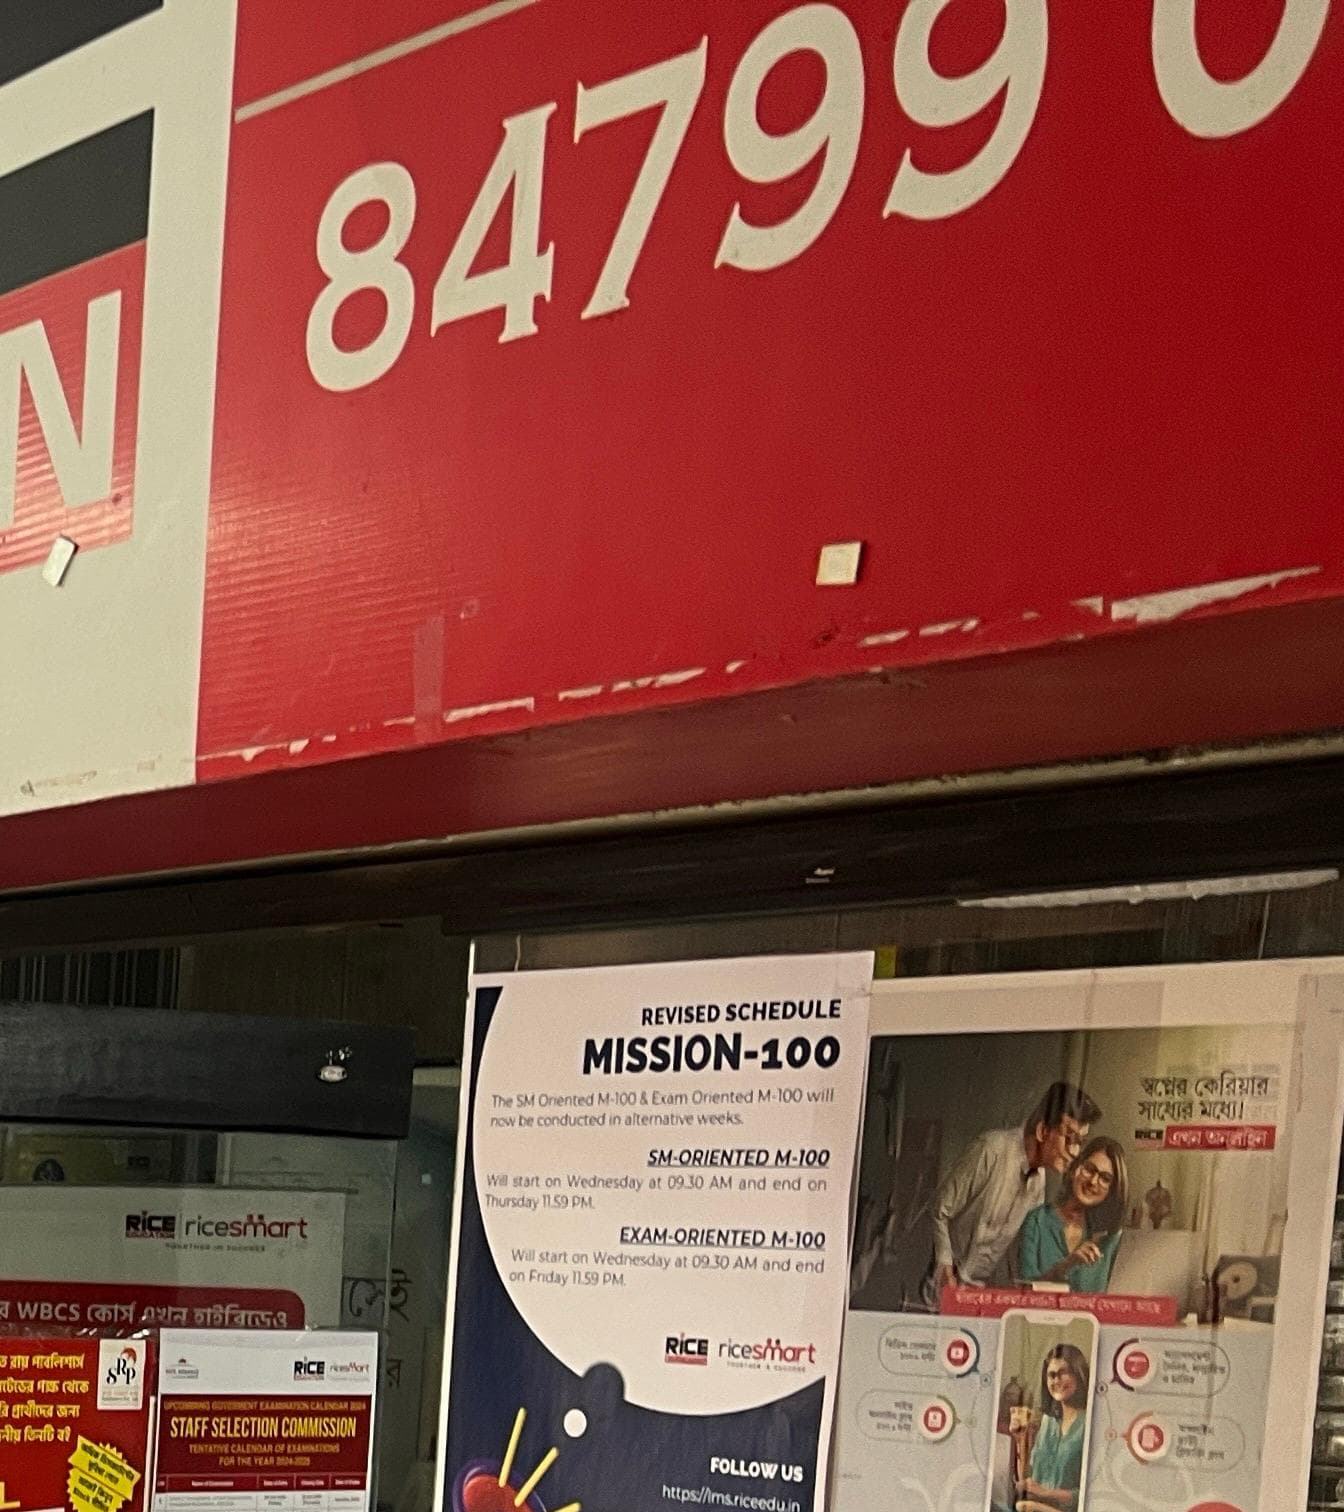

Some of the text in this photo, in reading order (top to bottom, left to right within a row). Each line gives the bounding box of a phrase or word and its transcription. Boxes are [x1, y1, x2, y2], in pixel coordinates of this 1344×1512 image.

[306, 0, 1051, 392] 84799
[642, 999, 841, 1025] REVISED SCHEDULE
[583, 1033, 841, 1075] MISSION-100
[492, 1088, 834, 1108] The SM Oriented M-100 & Exam Oriented M-100 will
[647, 1150, 830, 1168] SM-ORIENTED M-100
[620, 1227, 825, 1250] EXAM-ORIENTED M-100
[17, 1302, 80, 1321] WBCS
[170, 1416, 356, 1438] STAFF SELECTION COMMISSION
[711, 1457, 803, 1482] FOLLOW US
